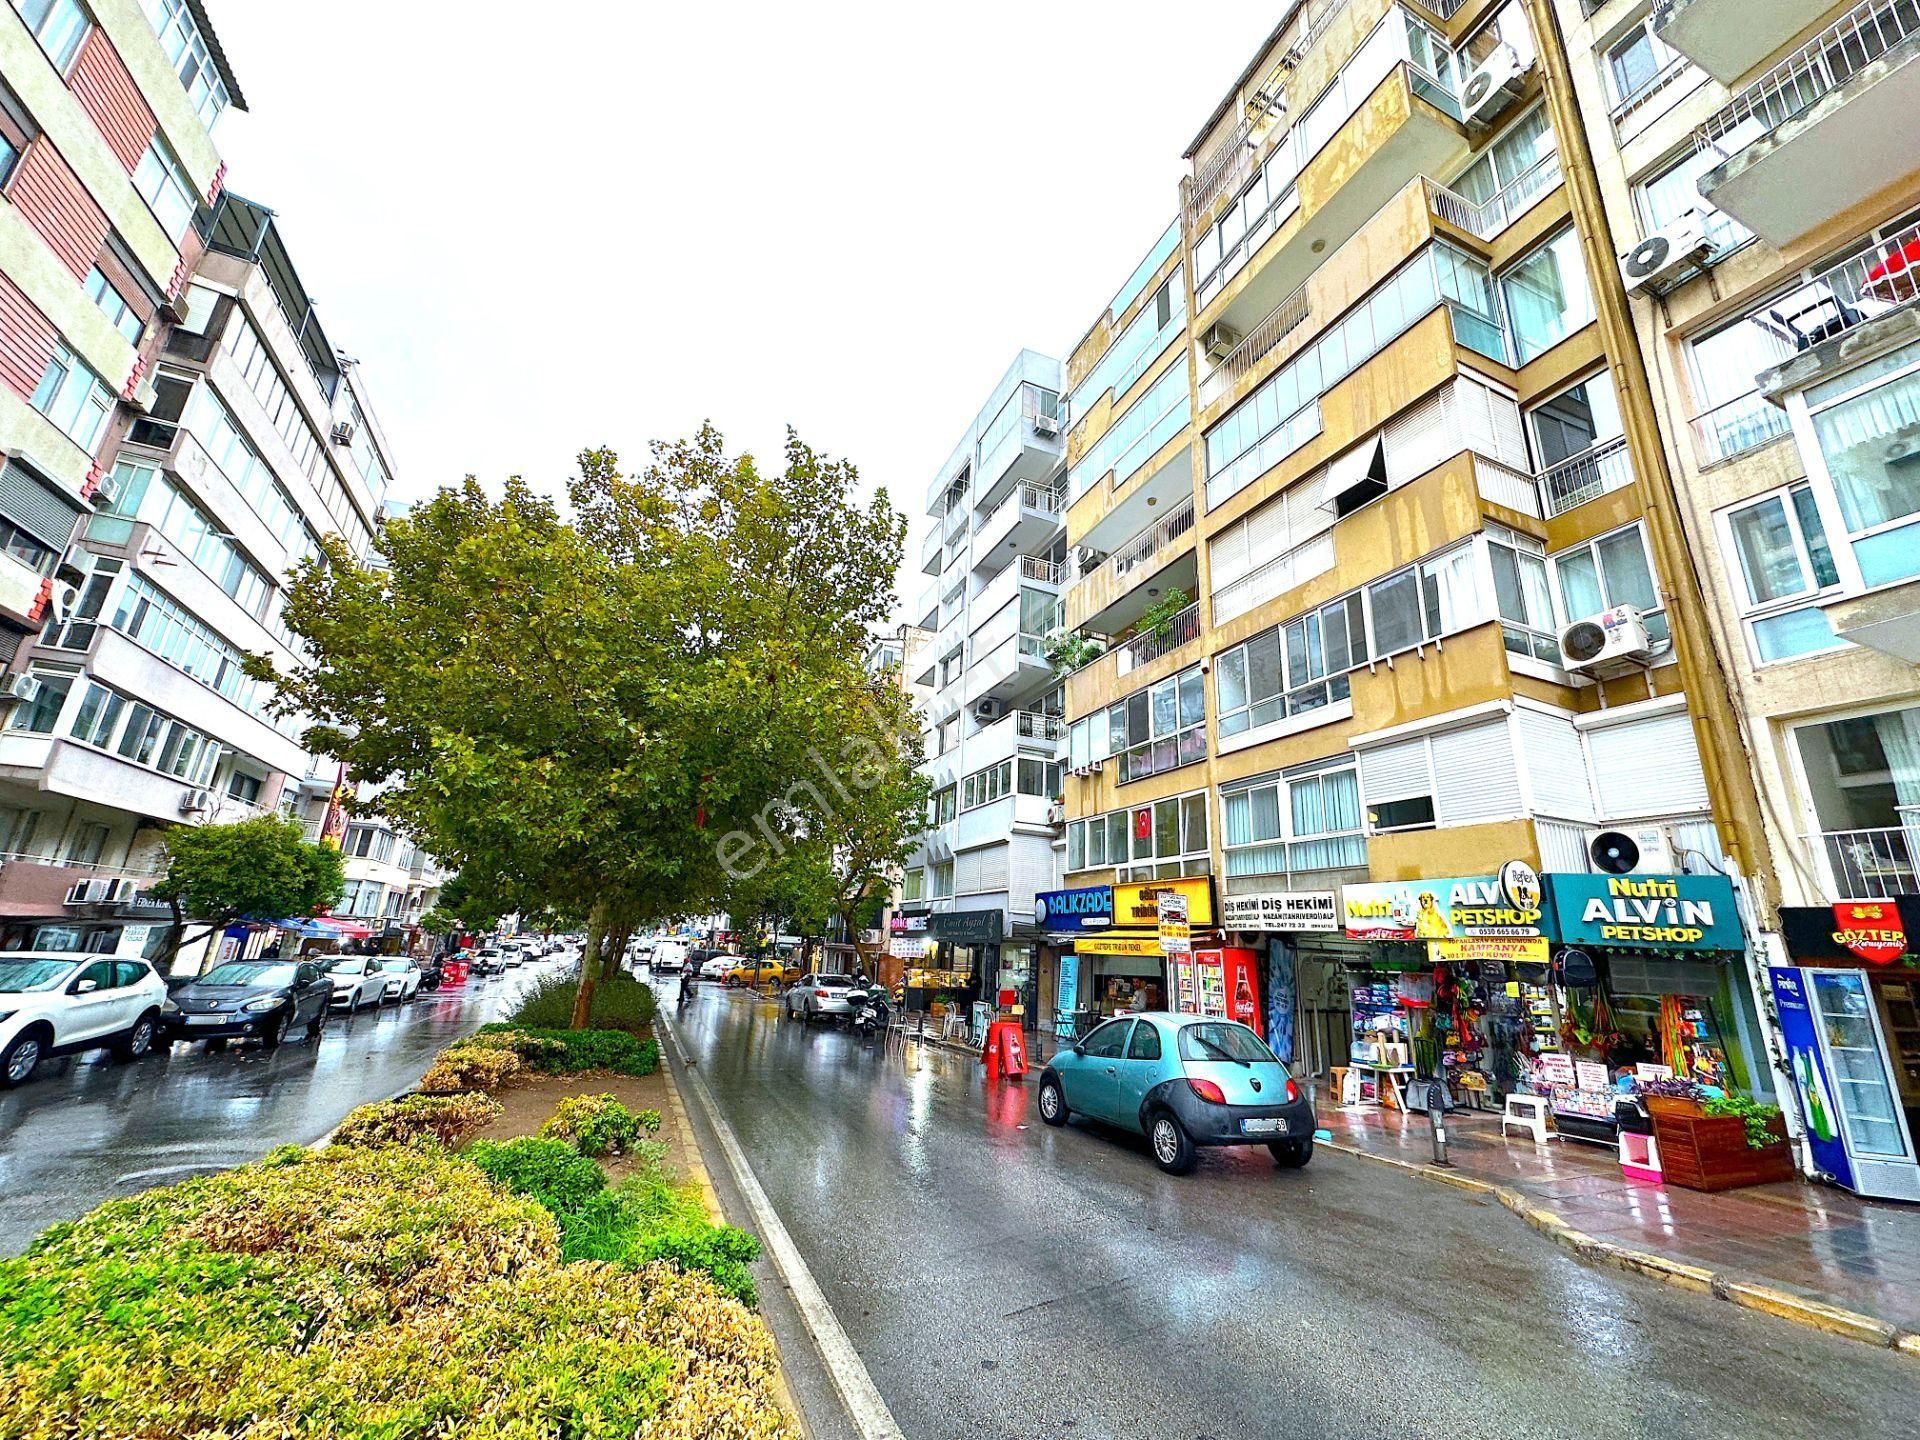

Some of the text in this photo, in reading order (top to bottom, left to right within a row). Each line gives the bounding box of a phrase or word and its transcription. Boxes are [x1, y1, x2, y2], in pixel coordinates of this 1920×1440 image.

[1511, 869, 1535, 885] Reflex
[1607, 877, 1678, 897] Nutri
[1261, 896, 1333, 912] DİŞ HEKİMİ
[1345, 899, 1391, 918] Nutri
[1449, 907, 1541, 926] PETSHOP
[1600, 925, 1703, 943] PETSHOP
[1460, 944, 1528, 953] KAMPANYA
